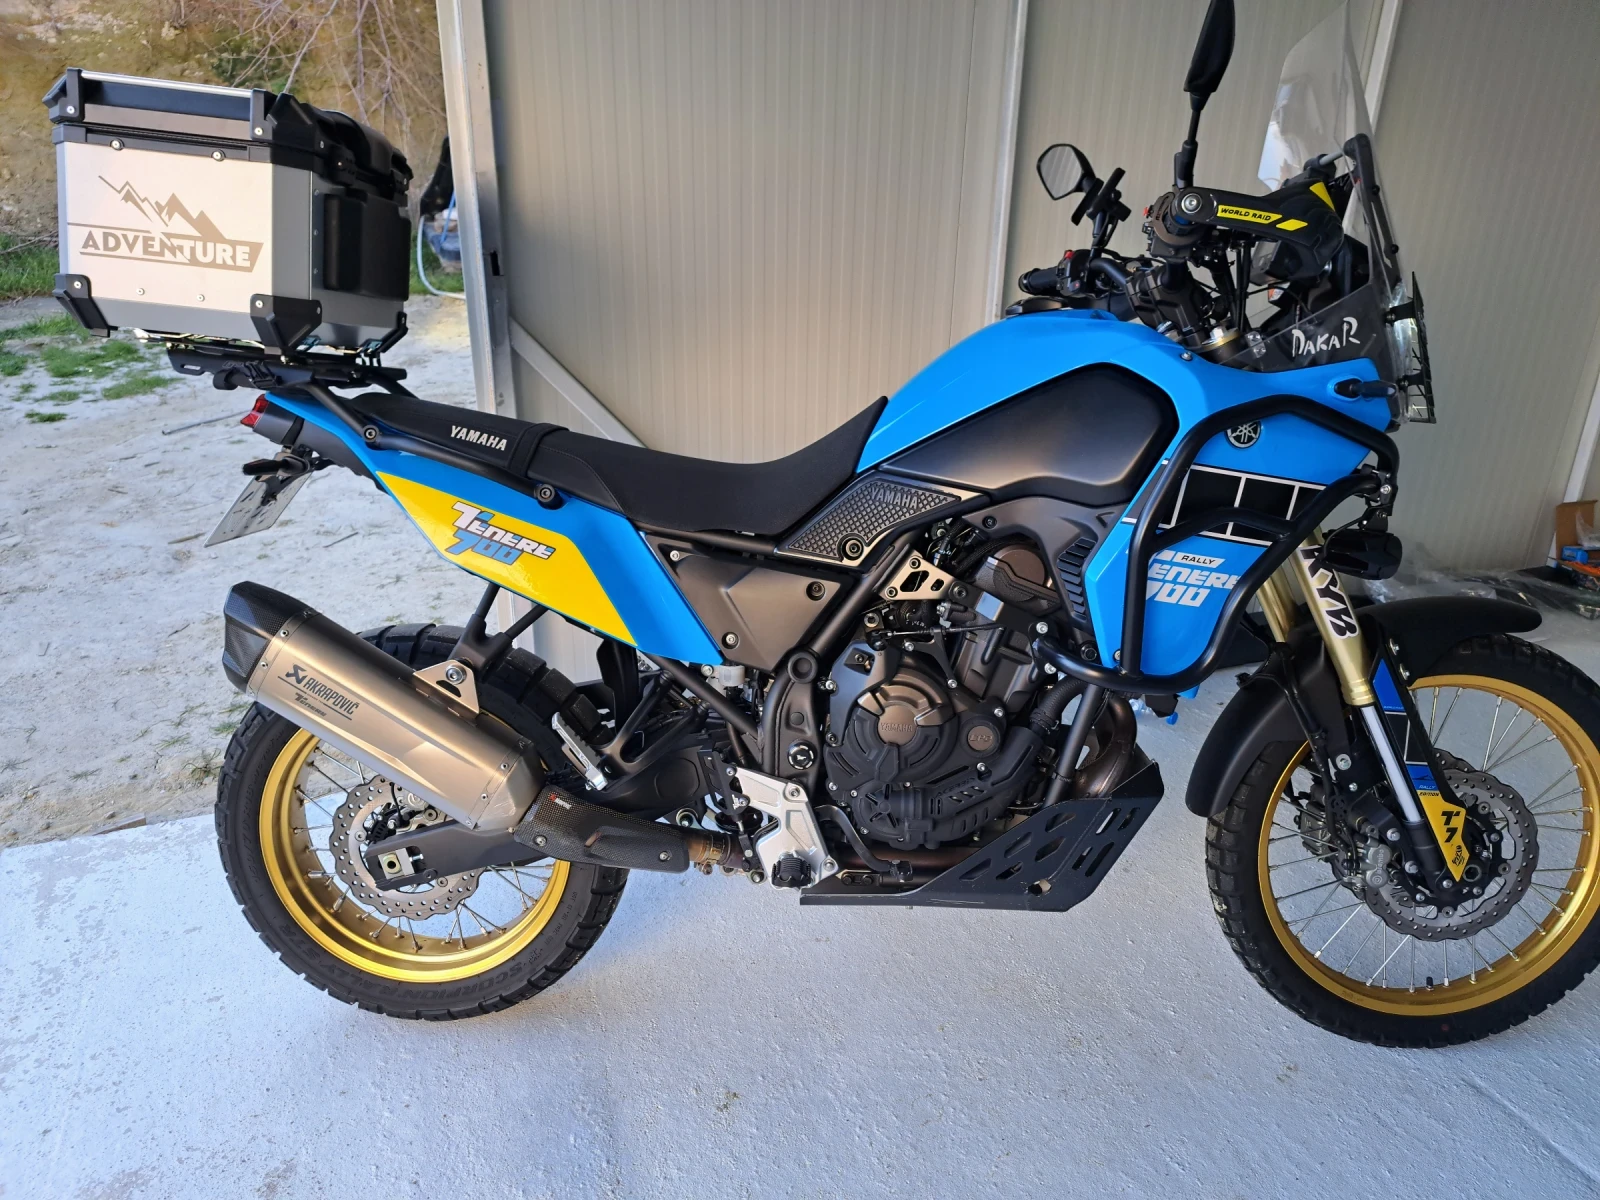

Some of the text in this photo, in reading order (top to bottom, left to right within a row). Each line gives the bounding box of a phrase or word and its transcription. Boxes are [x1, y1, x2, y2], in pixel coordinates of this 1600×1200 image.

[1220, 207, 1272, 221] WORLD RAID
[81, 229, 251, 268] ADVENTURE
[1291, 316, 1361, 358] DAKAR
[450, 425, 508, 451] YAMAHA
[870, 486, 918, 510] YAMAHA
[444, 528, 525, 566] 700
[1181, 554, 1216, 565] RALLY
[1297, 545, 1359, 639] KYB
[880, 721, 913, 733] YAMAHA
